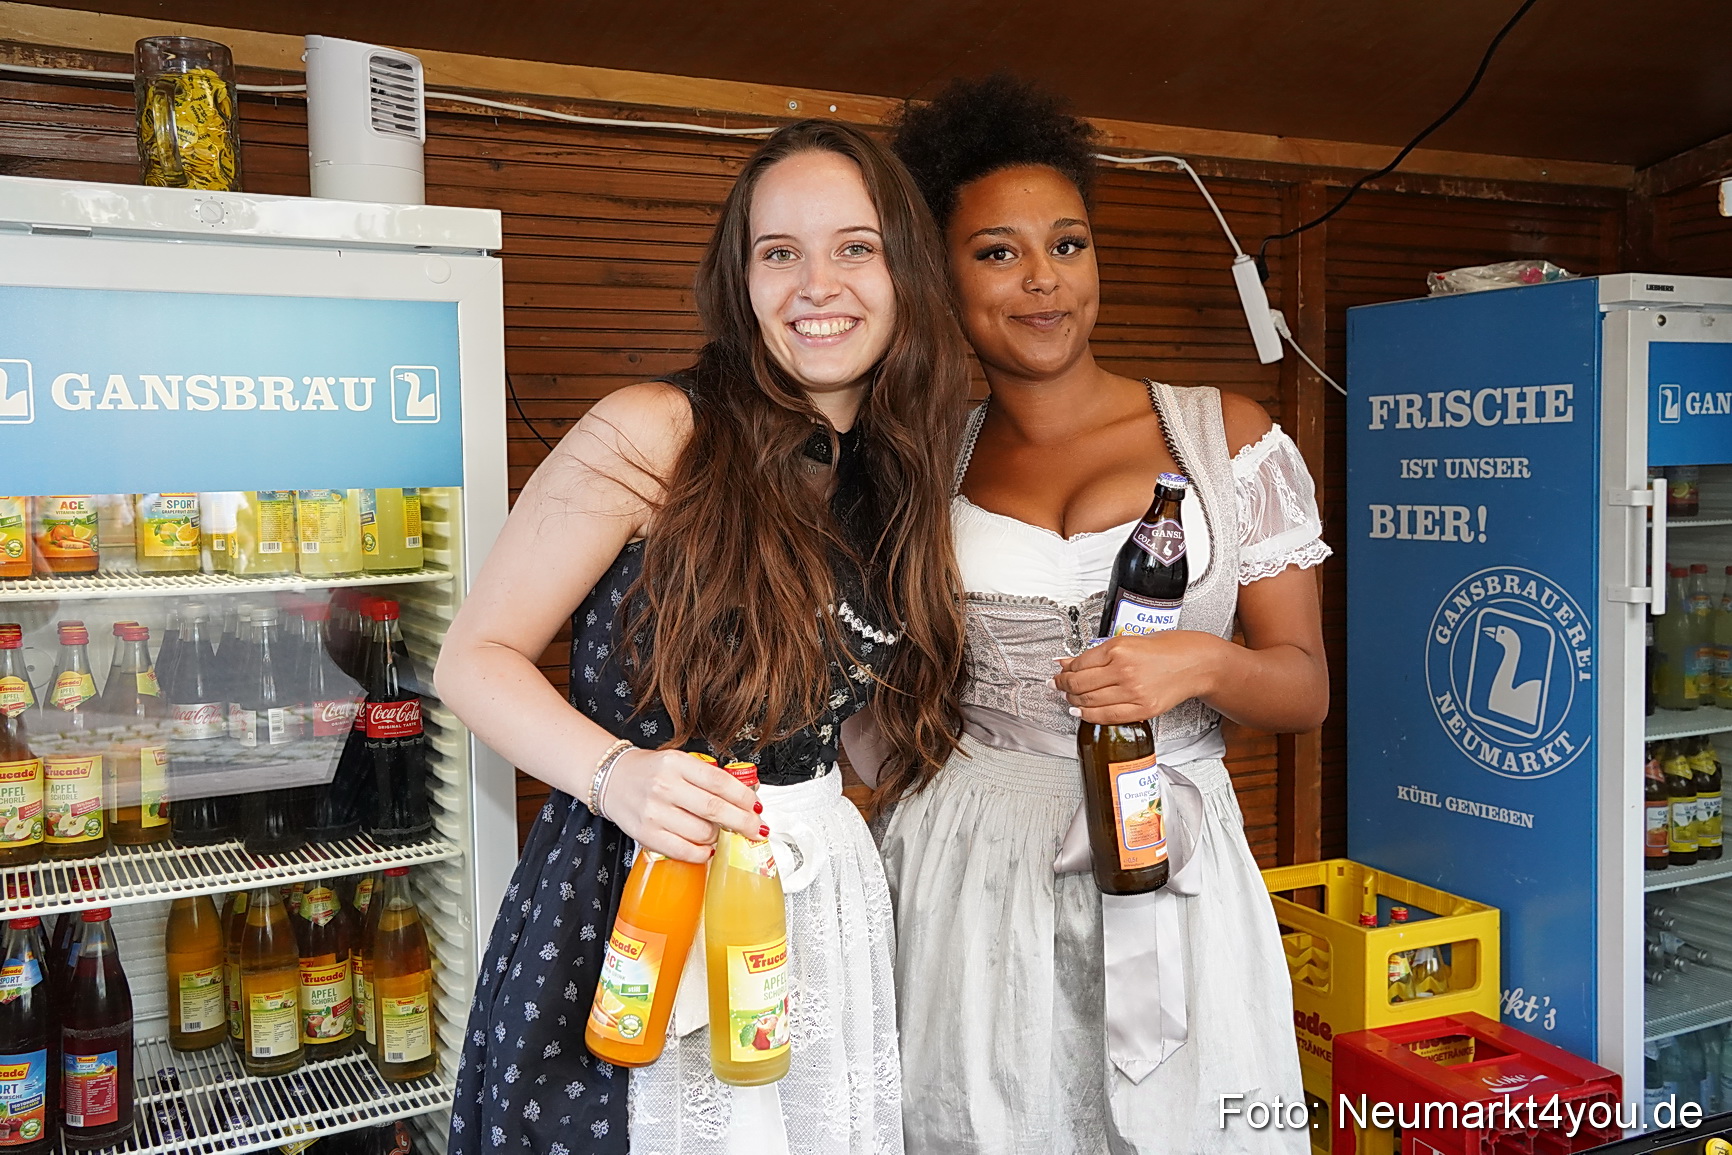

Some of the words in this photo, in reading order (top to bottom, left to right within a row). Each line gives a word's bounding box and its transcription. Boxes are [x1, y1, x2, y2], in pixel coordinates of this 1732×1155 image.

[1646, 284, 1675, 292] LIEBHERR
[51, 371, 377, 412] GANSBRÄU
[1367, 383, 1574, 431] FRISCHE
[1685, 392, 1732, 415] GAN
[1400, 459, 1438, 480] IST
[1443, 457, 1532, 480] UNSER
[60, 501, 85, 510] ACE
[166, 500, 195, 509] SPORT
[1368, 503, 1488, 544] BIER!
[1151, 530, 1183, 539] GANSL
[1136, 613, 1175, 624] GANSL
[1434, 573, 1592, 682] GANSBRAUEREI
[370, 701, 420, 725] Coca-Cola
[1435, 690, 1576, 774] NEUMARKT
[44, 764, 88, 776] Frucade
[50, 784, 78, 793] APFEL
[1397, 785, 1442, 808] KÜHL
[1445, 796, 1534, 829] GENIEßEN
[302, 971, 344, 983] Frucade
[311, 988, 338, 999] APFEL
[311, 996, 338, 1005] SCHORLE
